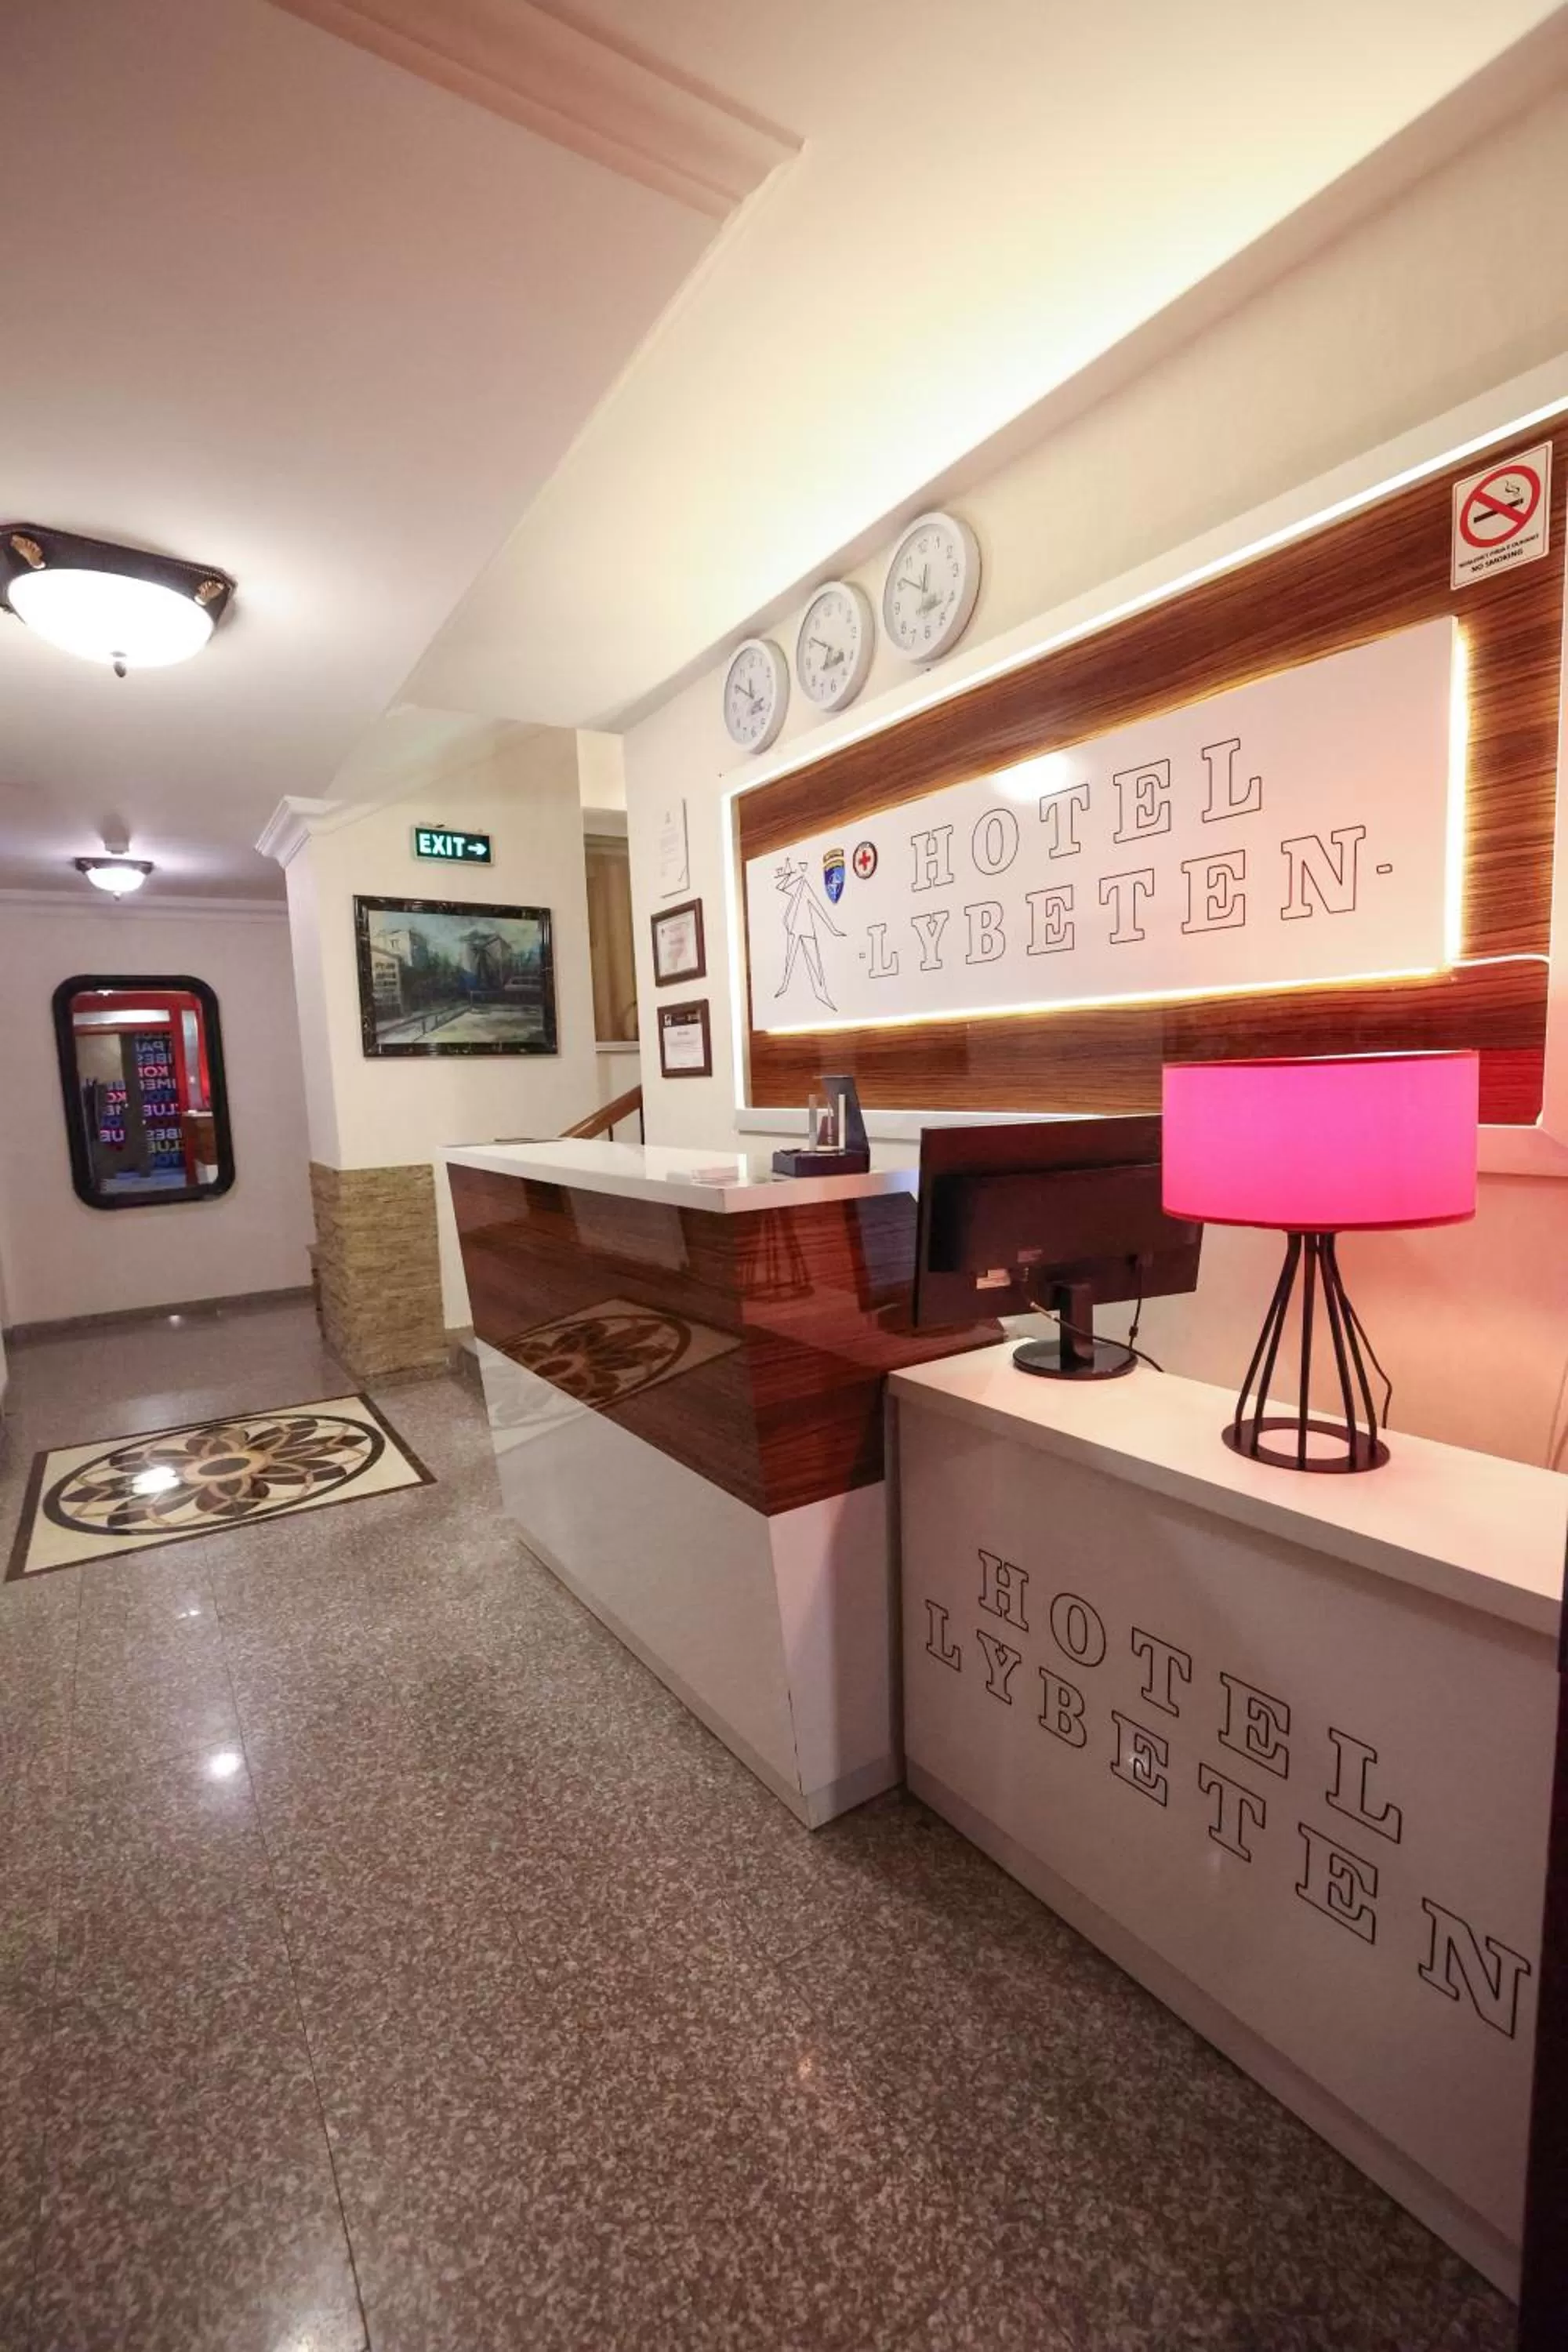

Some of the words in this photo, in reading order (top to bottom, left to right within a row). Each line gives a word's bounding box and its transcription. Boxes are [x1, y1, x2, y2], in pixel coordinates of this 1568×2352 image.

[419, 833, 465, 857] EXIT
[911, 738, 1262, 892] HOTEL
[978, 1548, 1402, 1844] HOTEL
[925, 1599, 1531, 2039] LYBETEN
